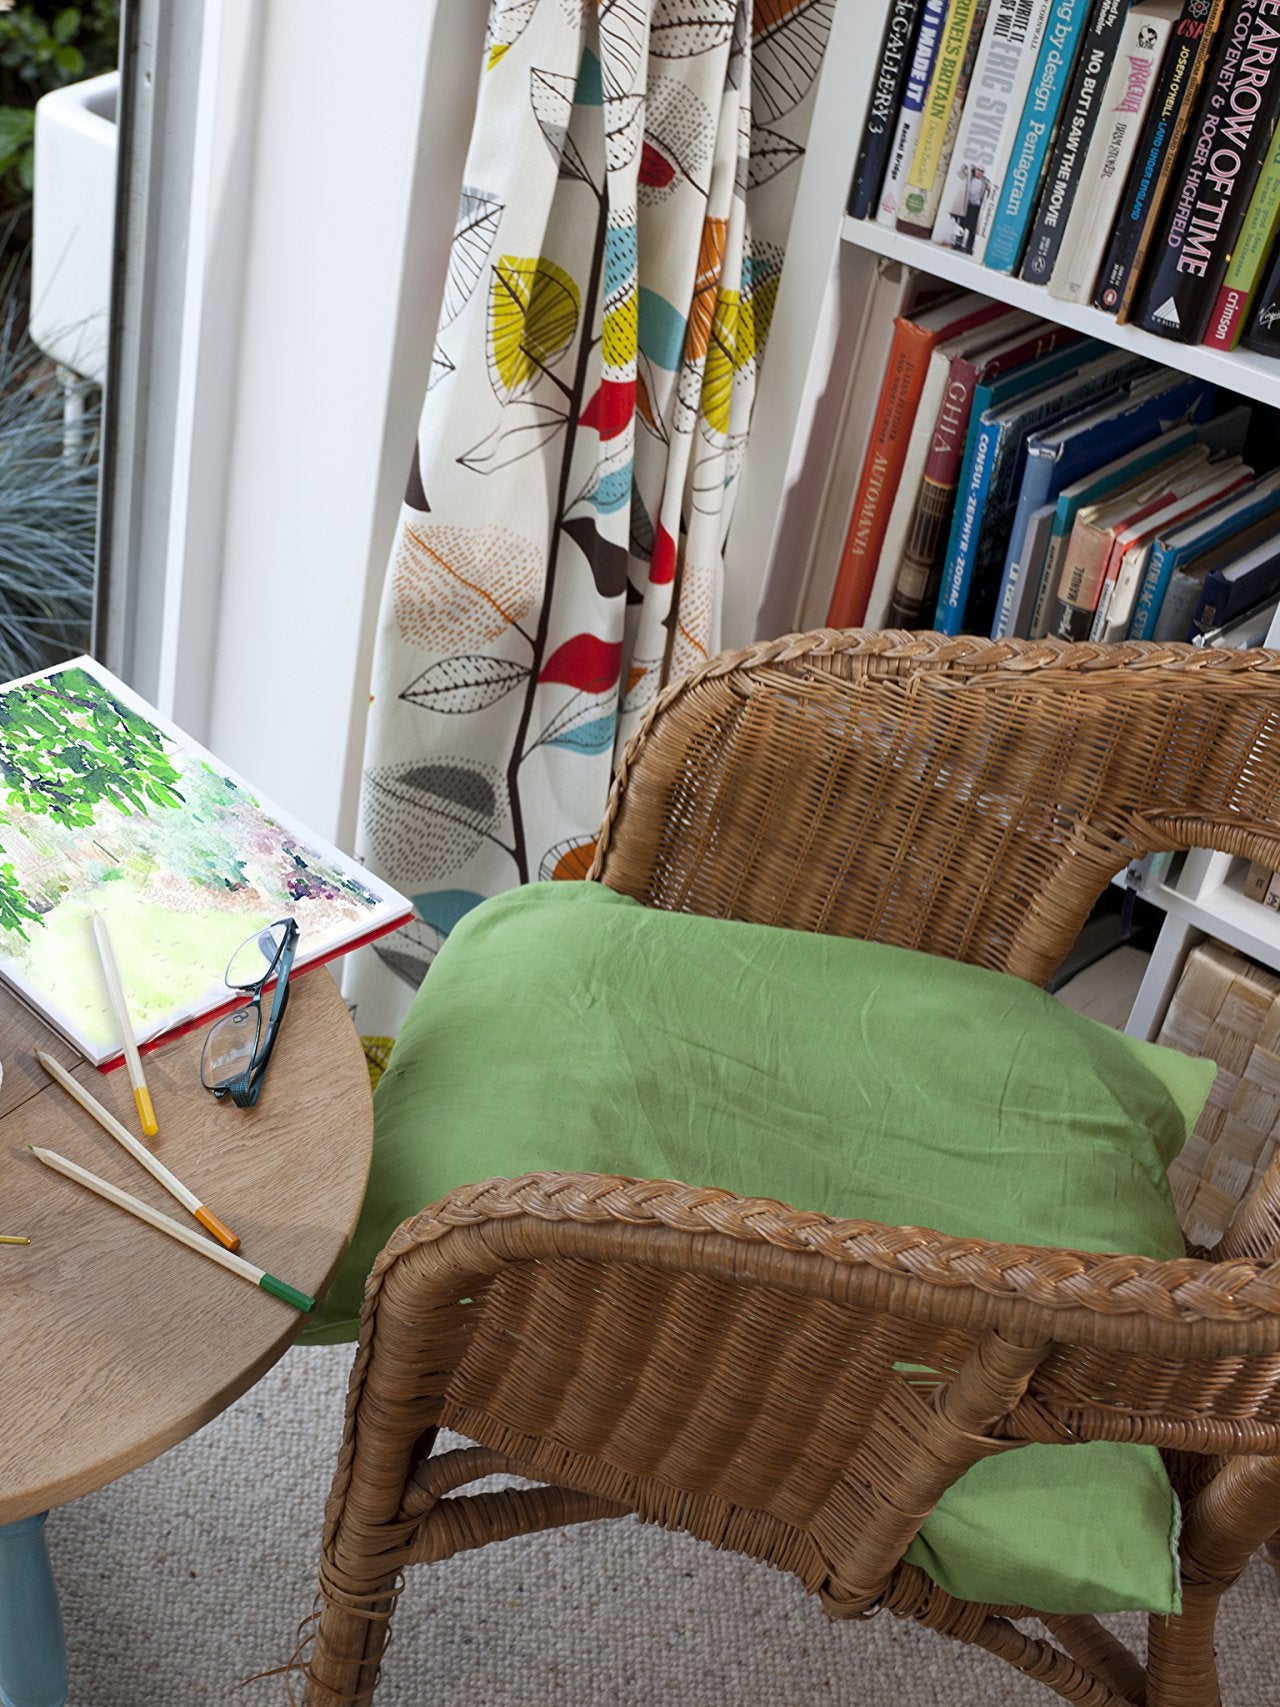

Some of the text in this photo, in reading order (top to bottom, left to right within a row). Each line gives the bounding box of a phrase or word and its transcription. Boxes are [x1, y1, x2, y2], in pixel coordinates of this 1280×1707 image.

[924, 14, 939, 25] I
[993, 14, 1013, 38] WILL
[1031, 5, 1048, 49] CORNWALL
[1050, 22, 1074, 50] by
[1106, 15, 1119, 28] by
[1204, 0, 1221, 38] AMBARD
[911, 25, 937, 81] MADE
[929, 0, 971, 120] RUNEL'S BRITAIN
[1173, 45, 1190, 84] JOSEPH
[1217, 12, 1252, 92] COVENEY
[906, 82, 924, 103] IT
[964, 40, 1022, 167] ERIC SYKES
[1034, 50, 1063, 112] design
[1109, 55, 1153, 115] DRACULA
[1212, 95, 1225, 108] &
[1220, 17, 1280, 151] ARROW
[868, 121, 883, 134] 3
[1044, 49, 1105, 228] NO, BUT I SAW THE MOVIE
[1153, 121, 1168, 147] LAND
[1168, 116, 1183, 149] RICHARD
[1192, 113, 1220, 167] ROGER
[1006, 119, 1047, 216] Pentagram
[1143, 147, 1160, 178] UNDER
[1205, 148, 1241, 196] OF
[1131, 178, 1152, 221] ENGLAND
[1167, 167, 1204, 248] HIGHFIELD
[1176, 199, 1229, 278] TIME
[1215, 291, 1239, 340] crimson
[934, 381, 967, 453] GHIA
[852, 452, 888, 556] AUTOMANIA
[1067, 566, 1085, 602] MANUAL
[1140, 552, 1165, 608] CADILLAC
